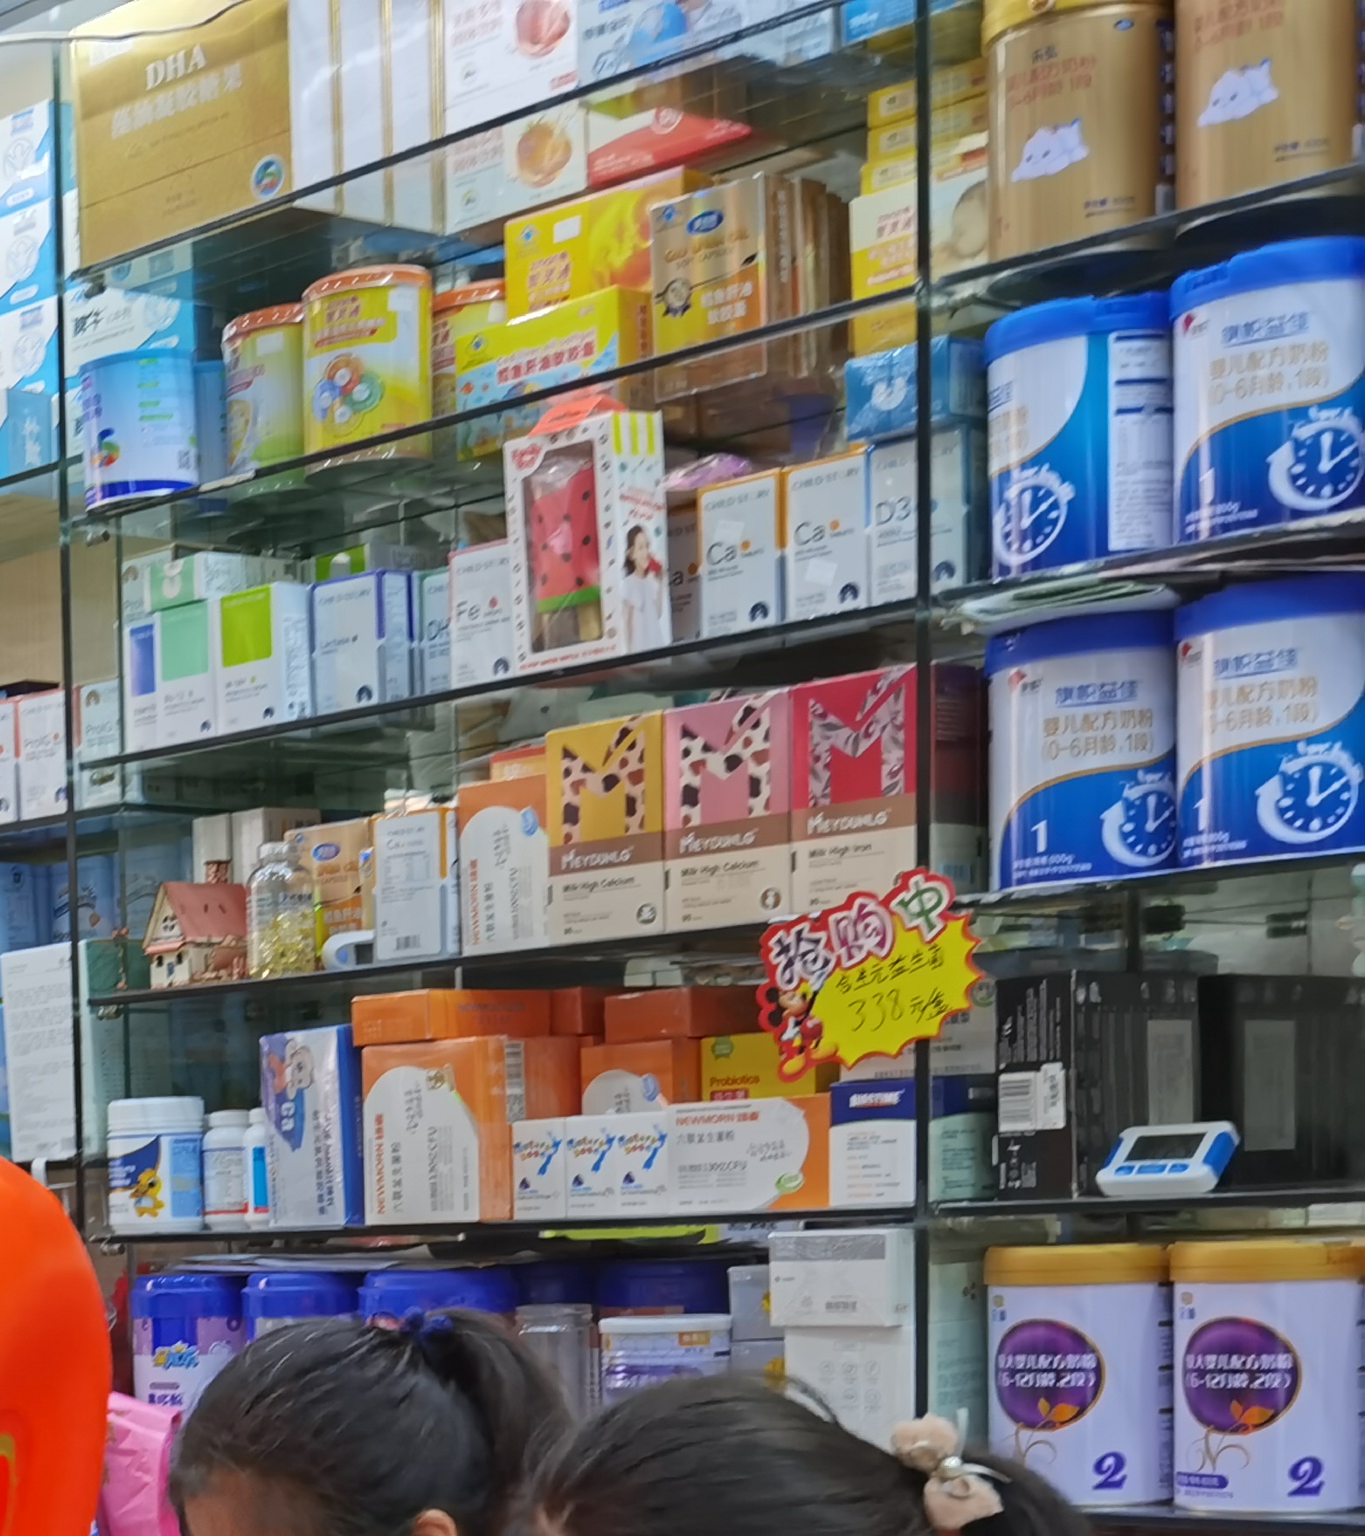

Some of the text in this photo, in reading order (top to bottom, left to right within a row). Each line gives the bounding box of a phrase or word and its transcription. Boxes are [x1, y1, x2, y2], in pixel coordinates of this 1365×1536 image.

[145, 43, 207, 91] DHA
[875, 497, 912, 526] D3
[793, 521, 826, 546] Ca
[706, 541, 738, 566] Ca
[456, 600, 481, 623] Fe
[1030, 819, 1048, 854] 1
[771, 875, 946, 991] 抢购中
[709, 1074, 761, 1087] Probiotics
[1091, 1451, 1129, 1492] 2
[1286, 1455, 1327, 1498] 2
